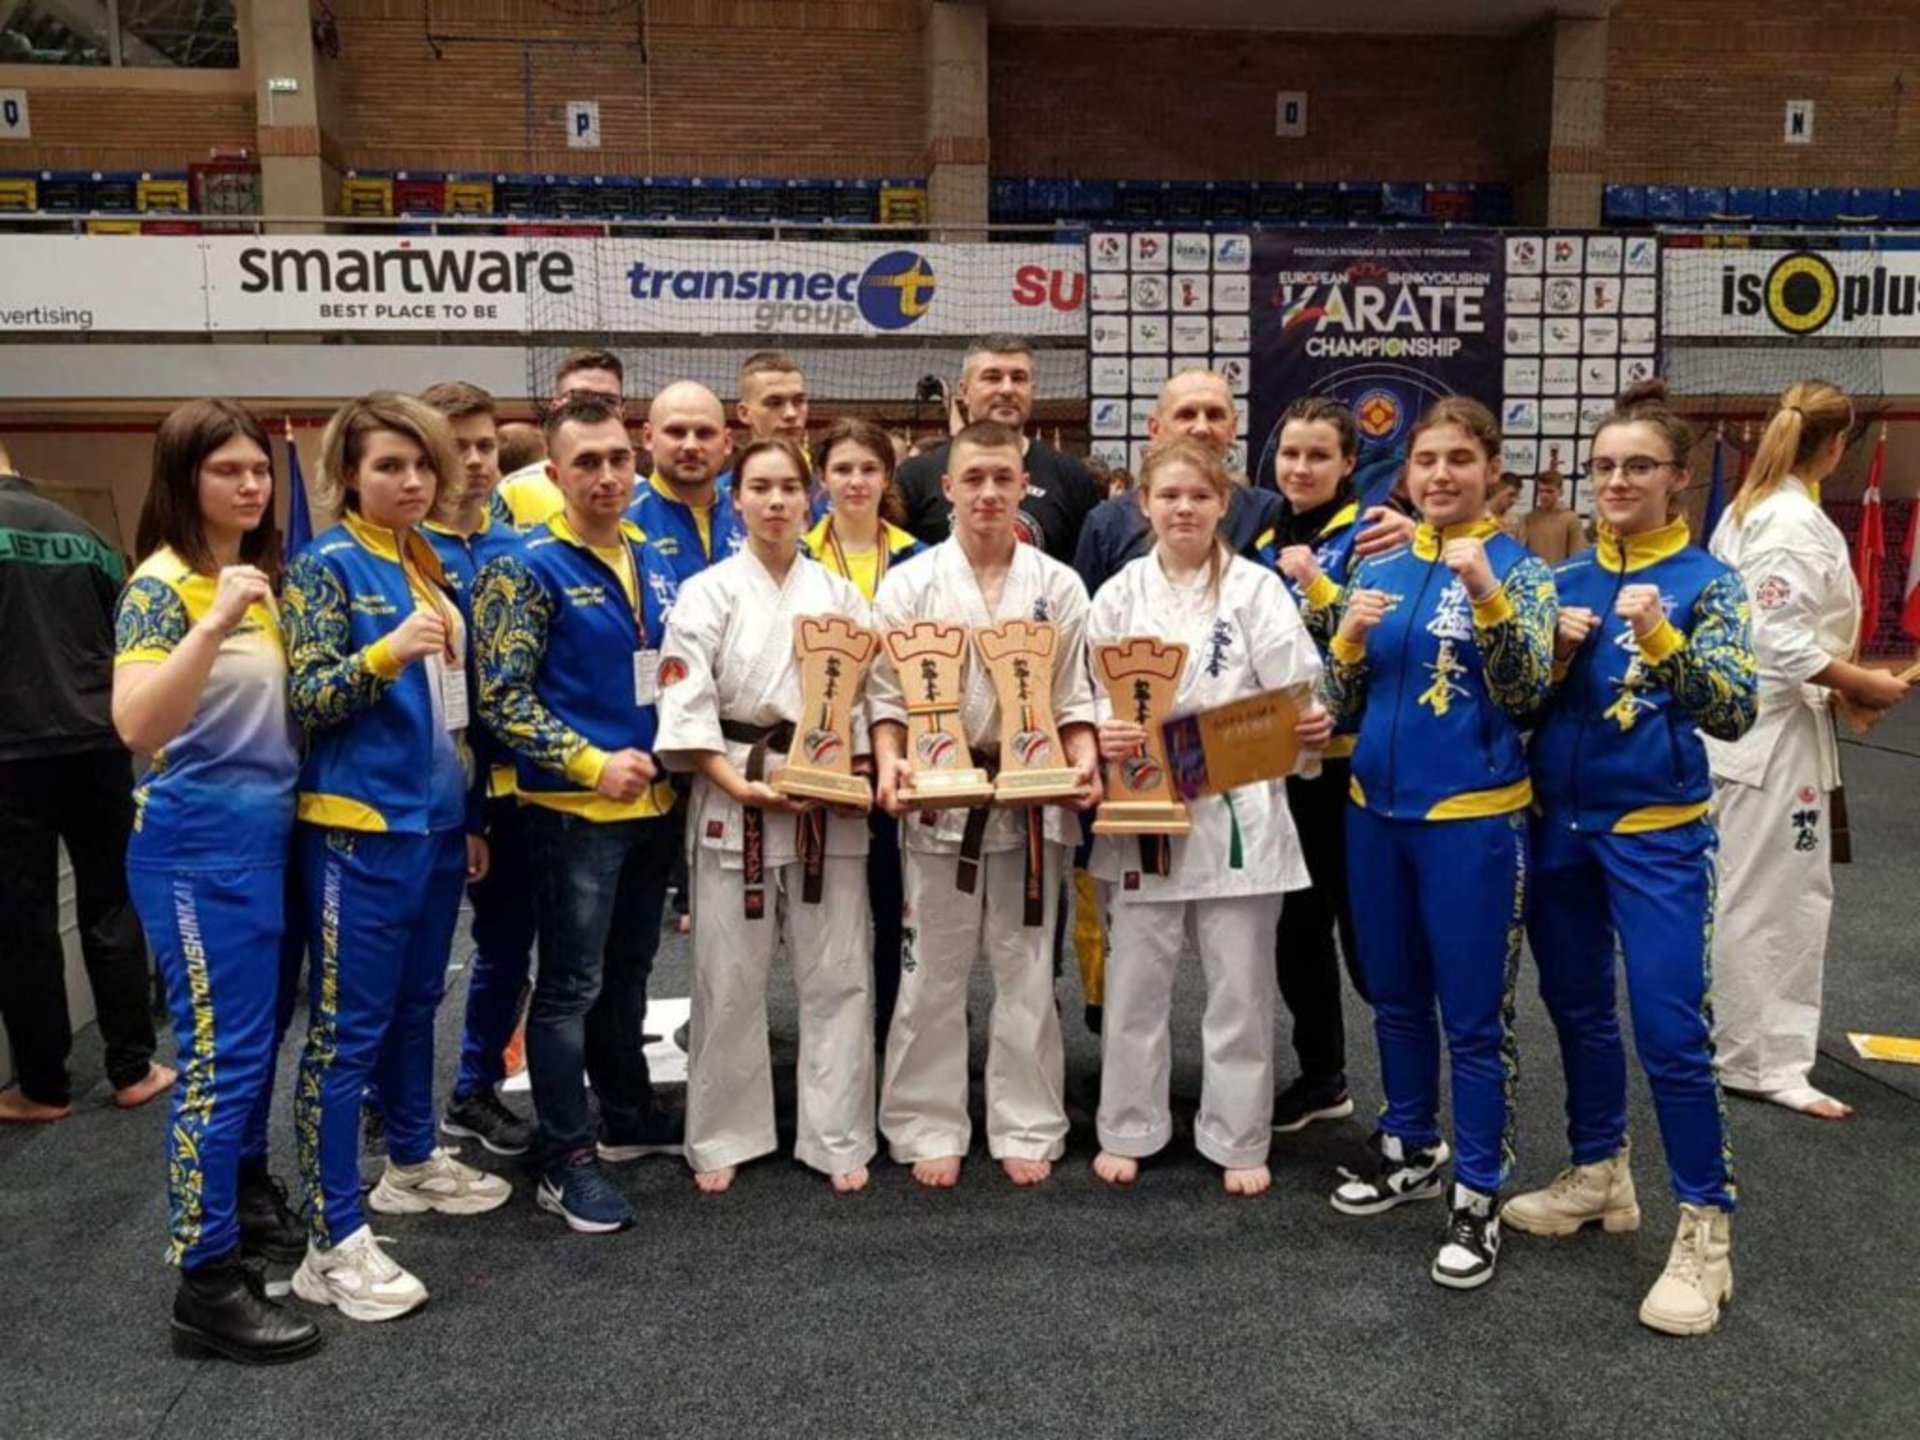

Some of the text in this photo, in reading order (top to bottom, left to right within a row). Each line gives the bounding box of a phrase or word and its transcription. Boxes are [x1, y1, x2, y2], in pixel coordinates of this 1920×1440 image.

[576, 113, 590, 137] P
[1792, 112, 1805, 135] N
[239, 241, 574, 294] smartware
[1279, 271, 1491, 285] EUROPEAN SHINKYOKUSHIN
[626, 261, 858, 301] transmec
[320, 304, 498, 319] BEST PLACE TO BE
[755, 303, 857, 331] group
[1277, 284, 1485, 333] KARATE
[1305, 338, 1463, 357] CHAMPIONSHIP
